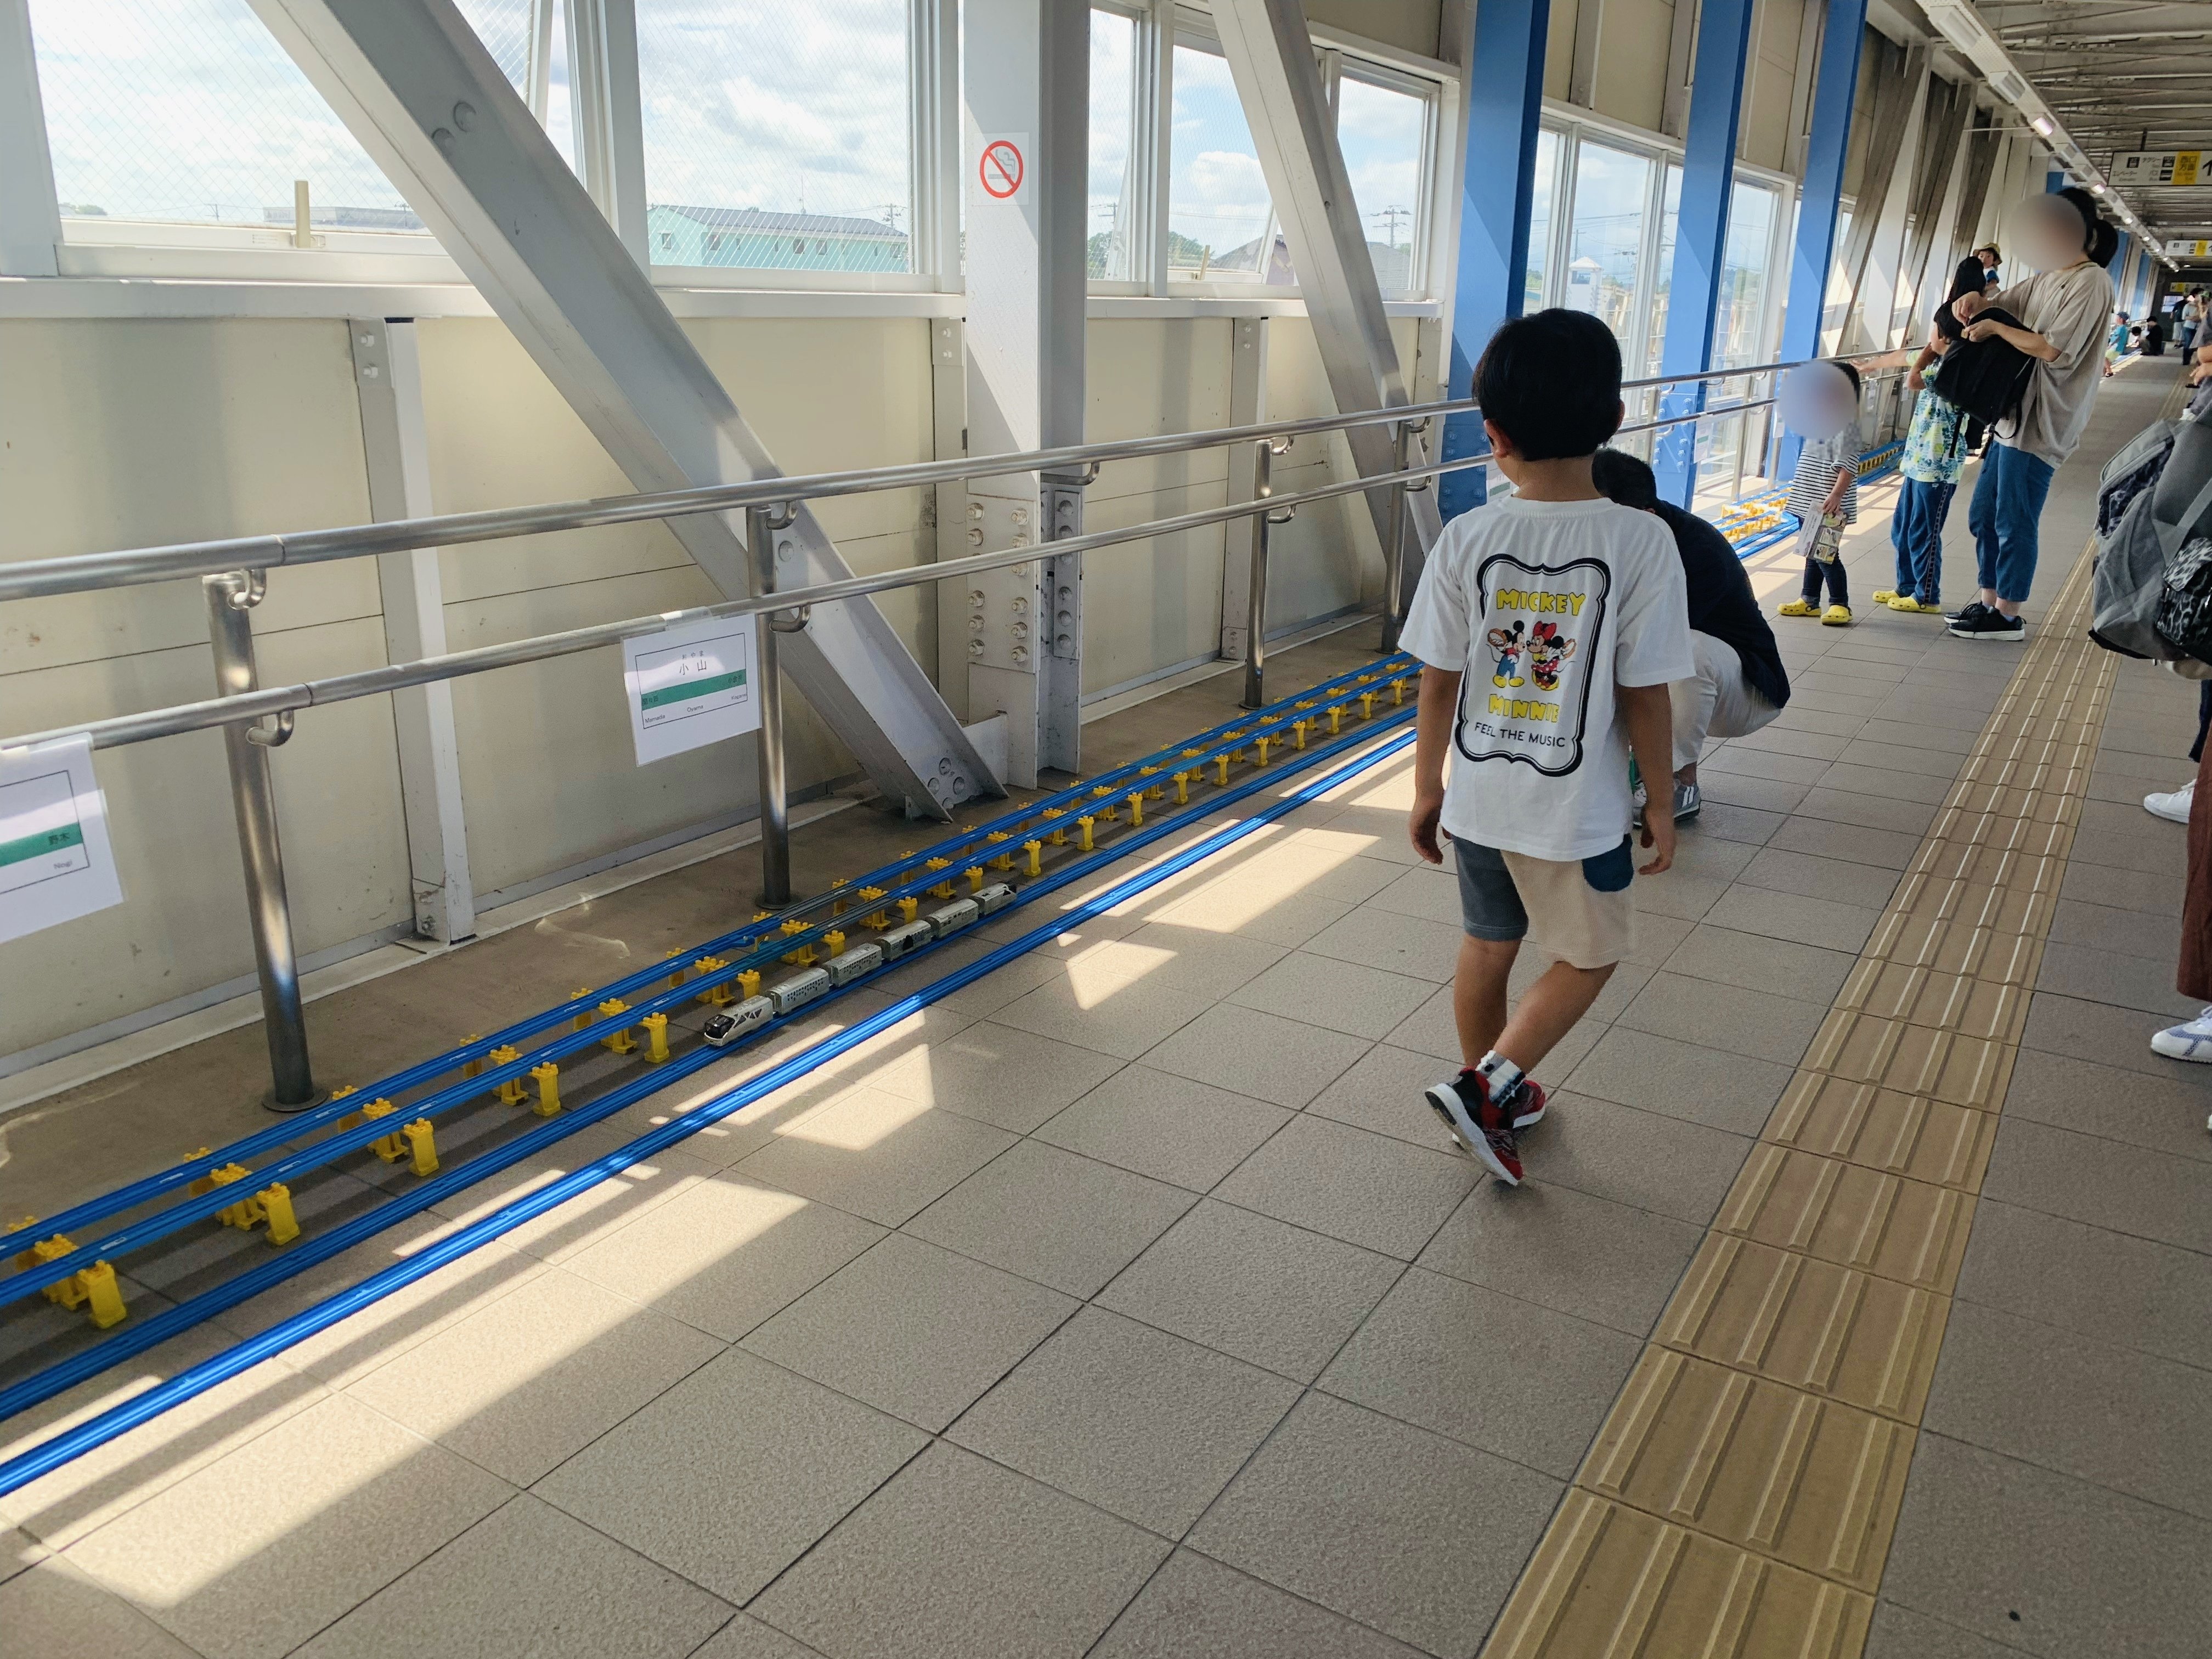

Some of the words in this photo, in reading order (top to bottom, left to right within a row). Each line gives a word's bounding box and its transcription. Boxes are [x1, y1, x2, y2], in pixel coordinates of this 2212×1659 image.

[1496, 589, 1585, 616] MICKEY
[679, 659, 707, 675] 小山
[645, 714, 665, 723] Mamada
[1488, 694, 1559, 723] MINNIE
[1475, 722, 1496, 737] FEEL
[1500, 729, 1525, 741] THE
[1528, 732, 1565, 747] MUSIC
